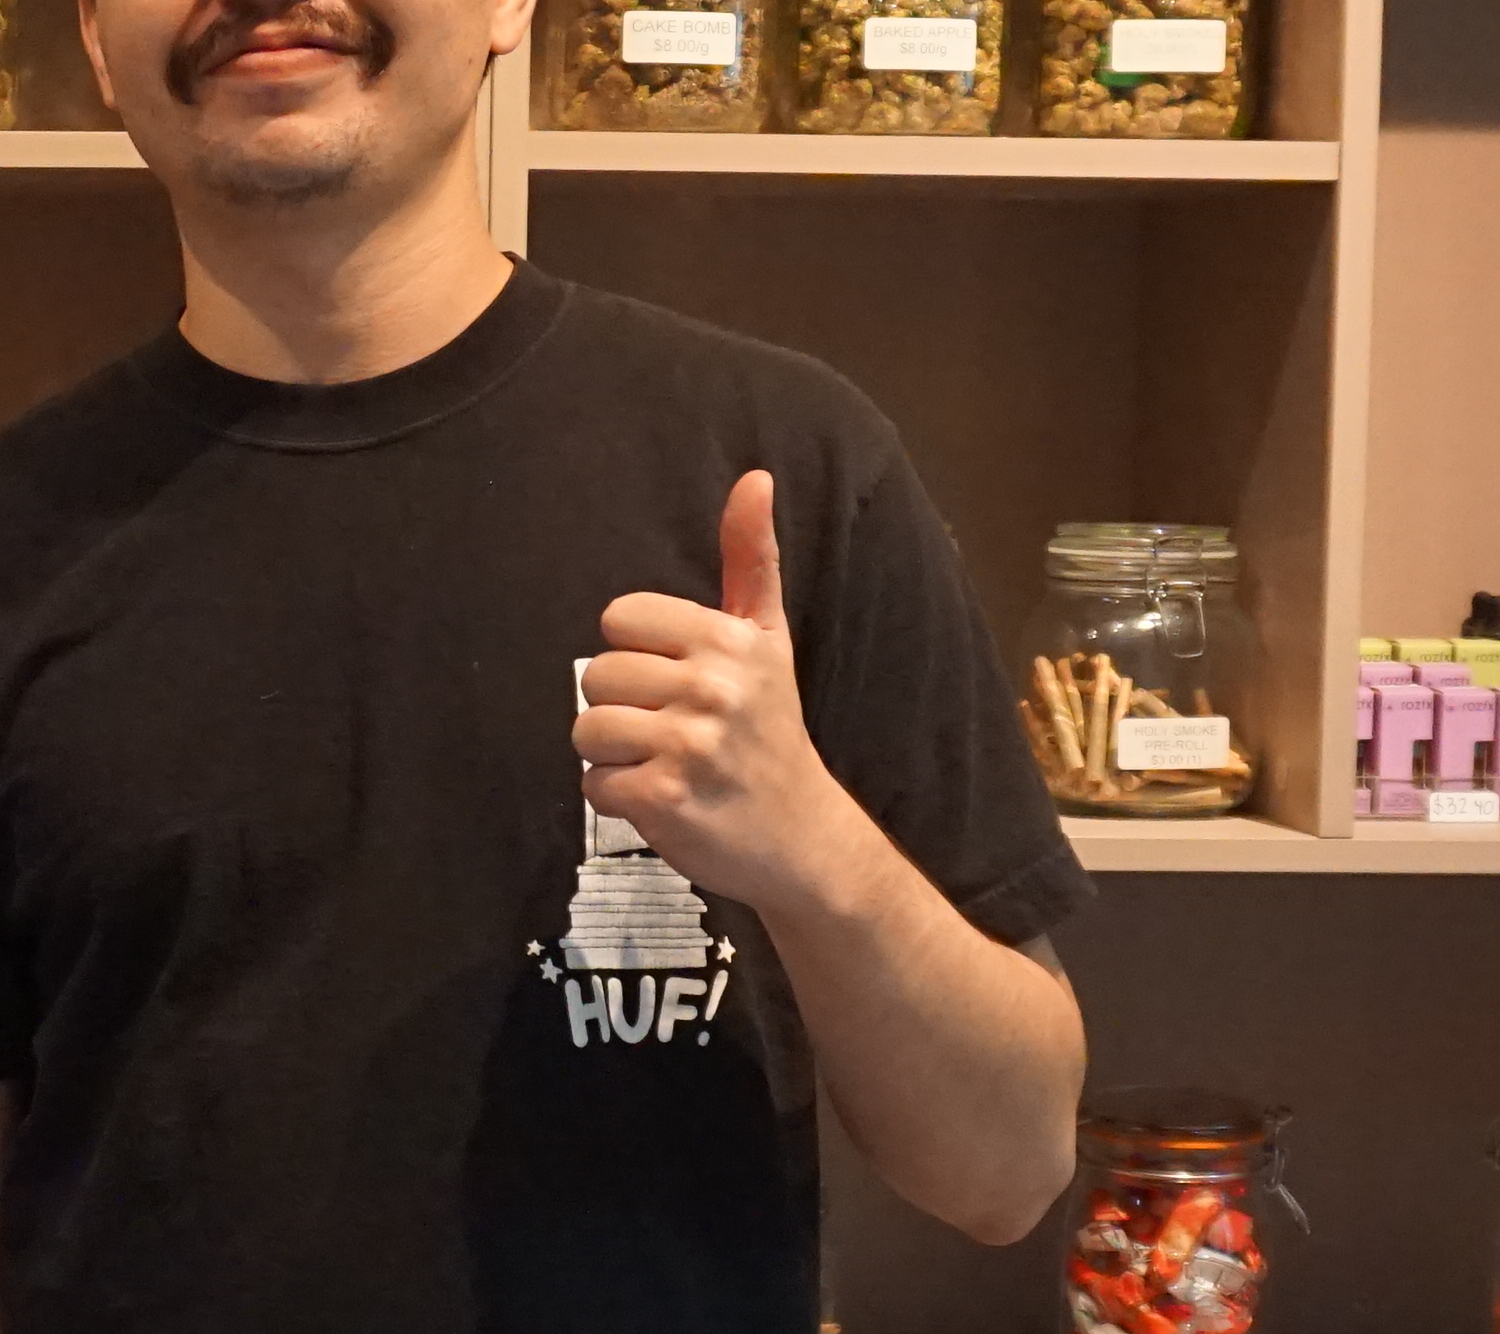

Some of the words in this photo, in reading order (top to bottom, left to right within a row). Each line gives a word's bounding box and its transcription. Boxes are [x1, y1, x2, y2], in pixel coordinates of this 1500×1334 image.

[631, 18, 677, 33] CAKE
[683, 19, 731, 35] BOMB
[873, 25, 924, 38] BAKED
[927, 26, 972, 39] APPLE
[653, 38, 710, 57] $800/g
[899, 42, 948, 58] $800/g
[1134, 726, 1168, 737] HOLY
[1173, 724, 1218, 737] SMOKE
[1144, 739, 1208, 751] PRE-ROLL
[1151, 754, 1184, 766] $300
[1432, 794, 1494, 816] $3240
[563, 969, 731, 1049] HUF!
